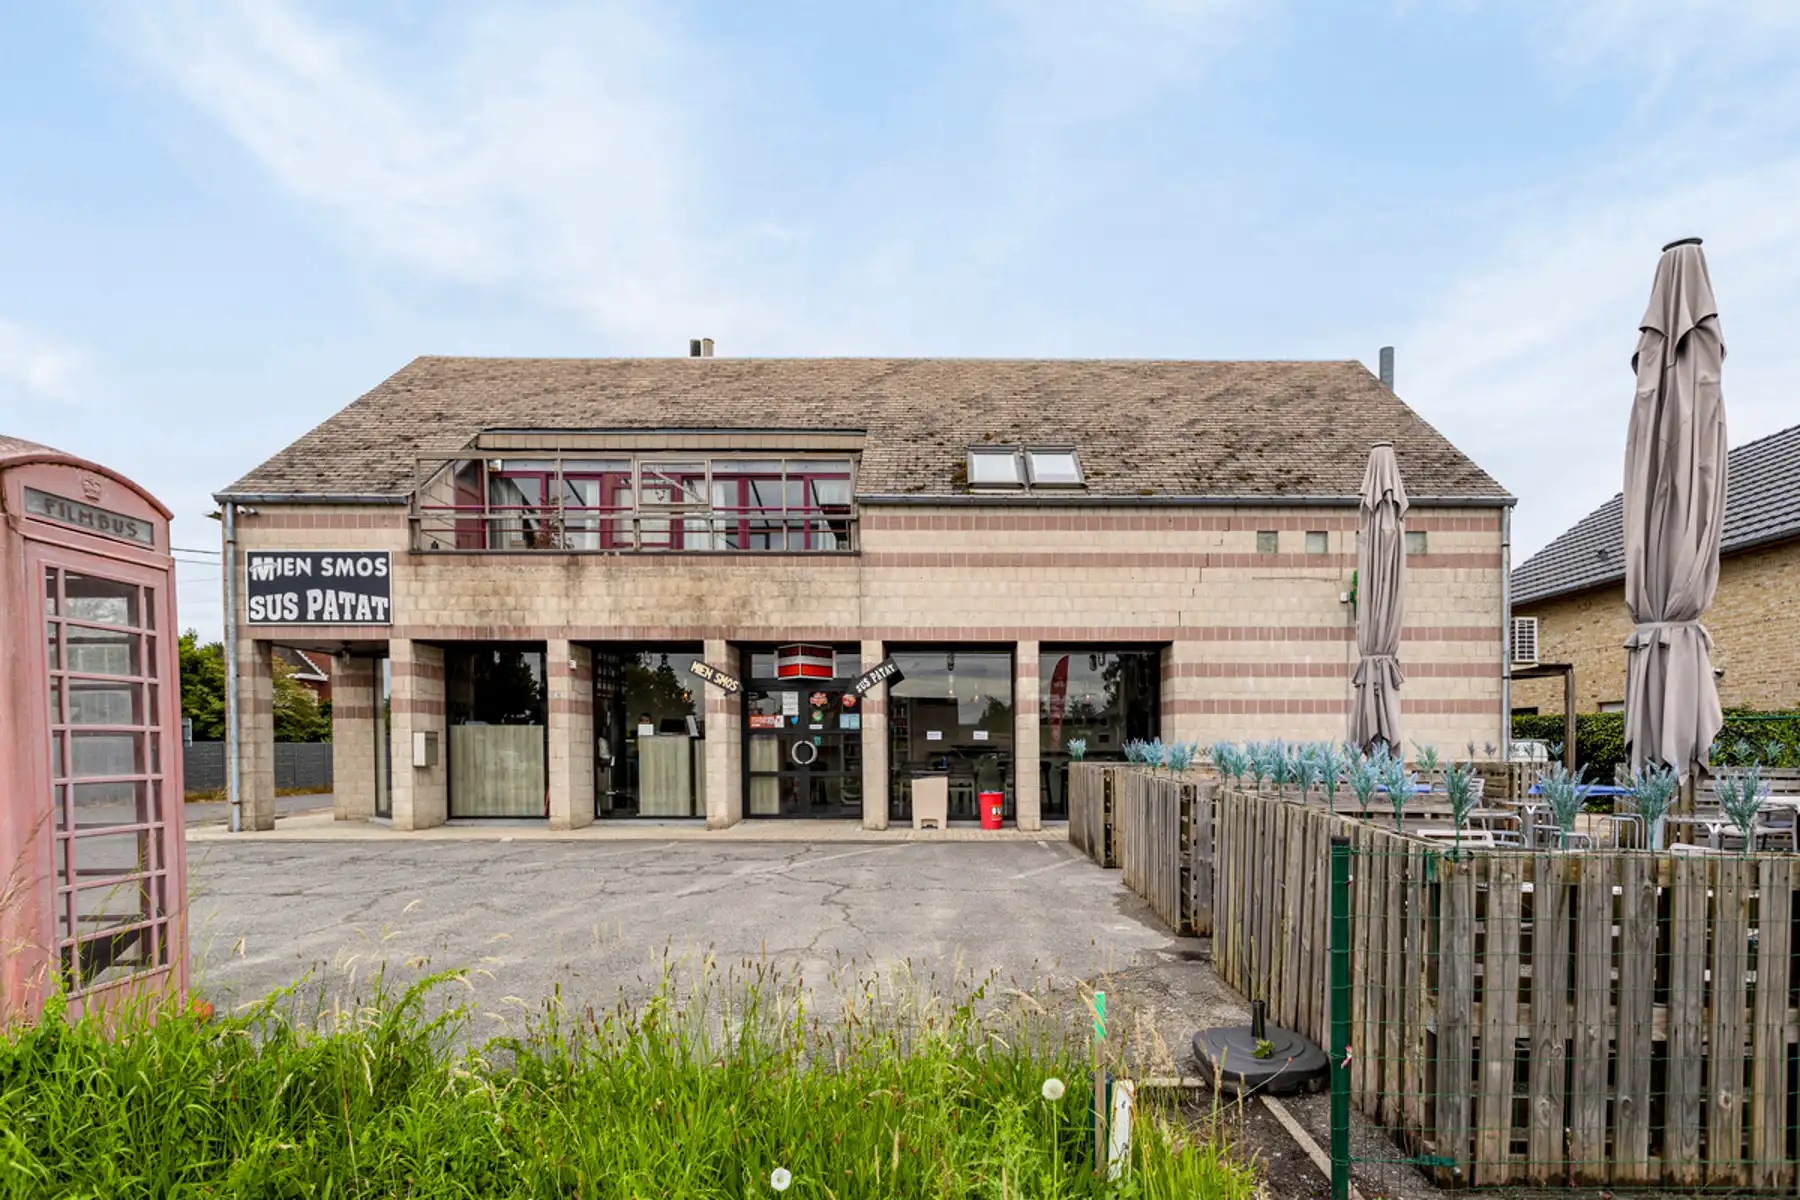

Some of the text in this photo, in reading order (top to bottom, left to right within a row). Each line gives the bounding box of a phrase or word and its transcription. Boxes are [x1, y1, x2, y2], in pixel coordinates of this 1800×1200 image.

[250, 557, 388, 581] MIEN SMOS
[250, 588, 389, 621] SUS PATAT
[690, 660, 739, 691] MIEN SMOS
[869, 663, 895, 683] PATAT
